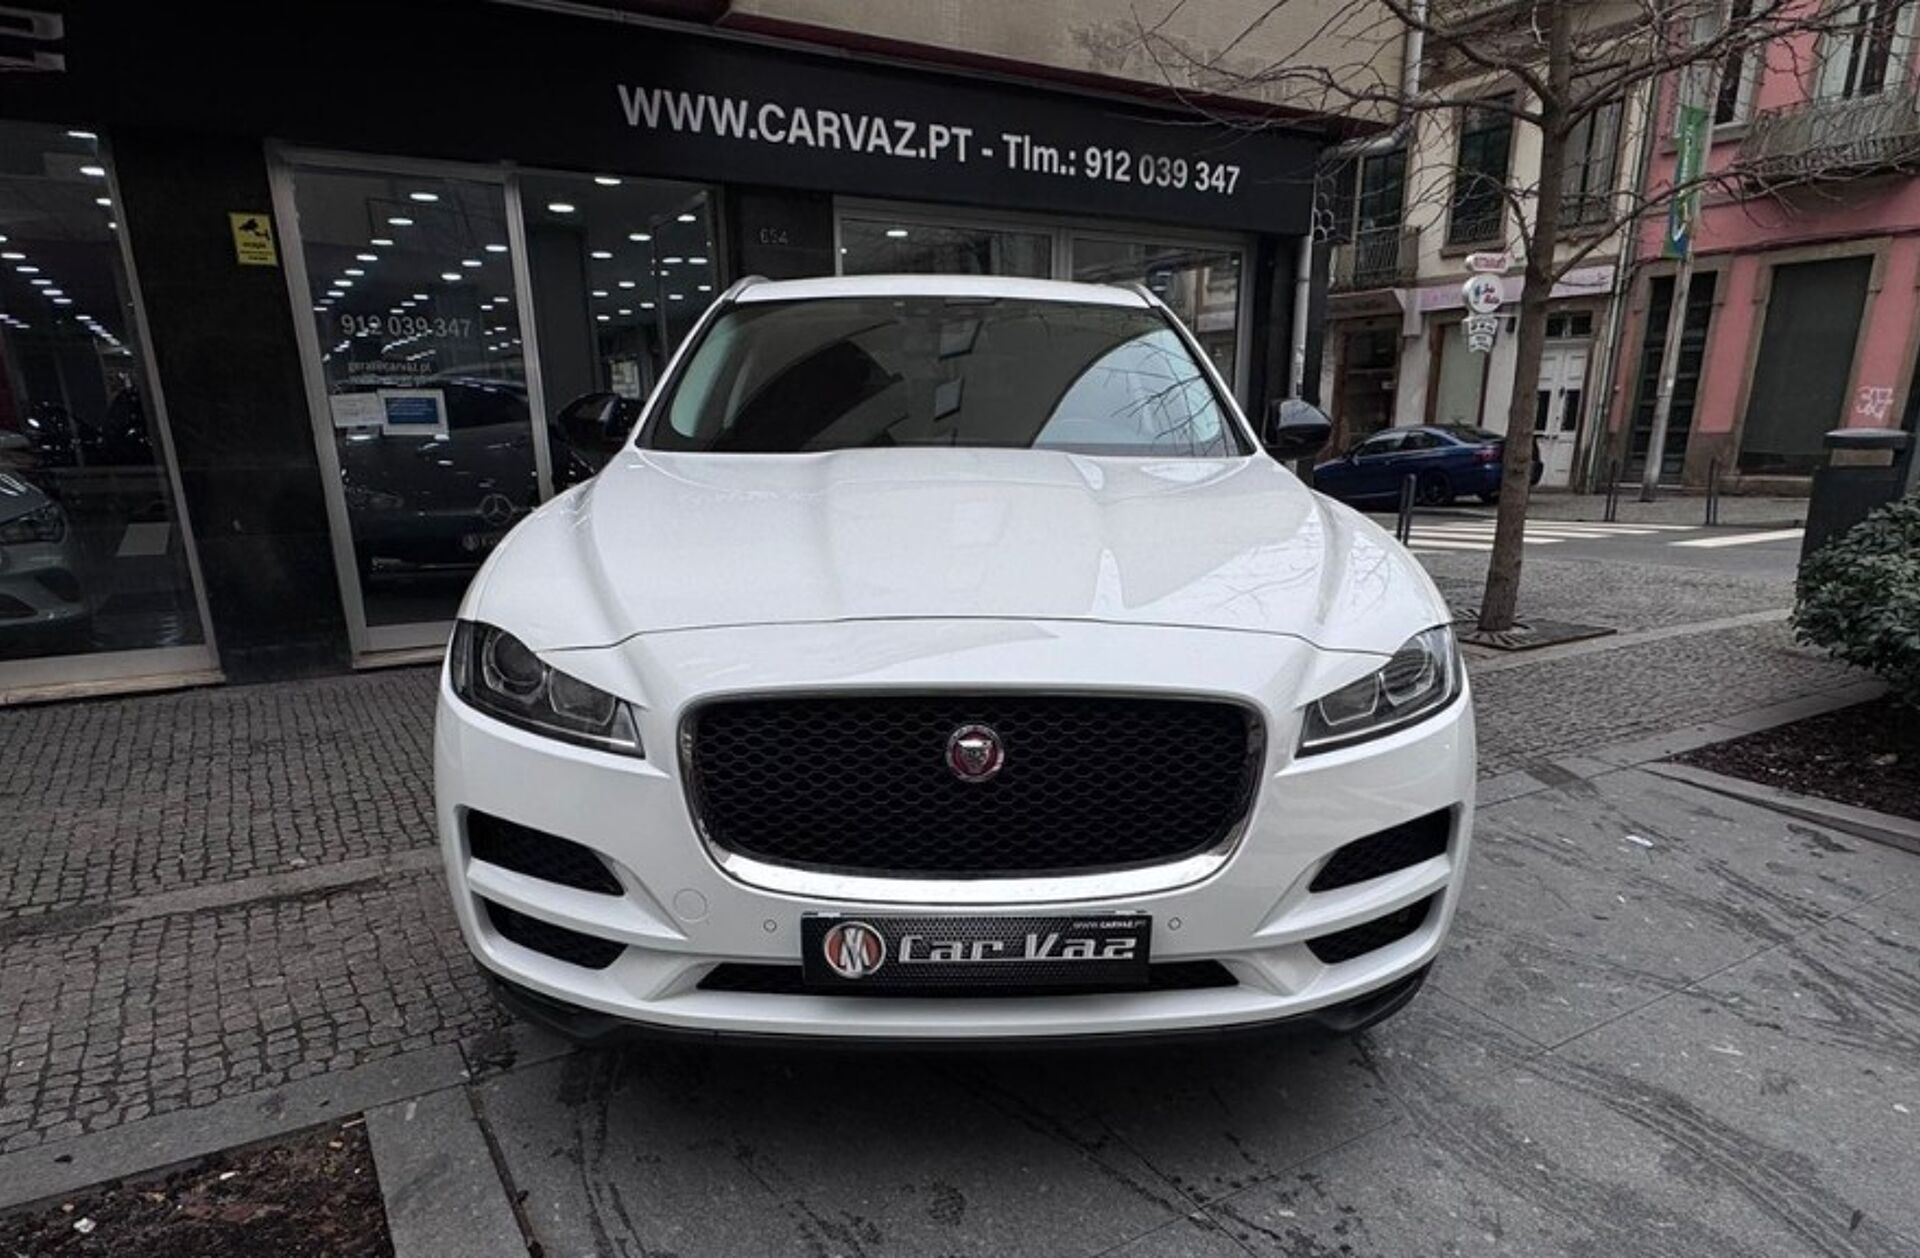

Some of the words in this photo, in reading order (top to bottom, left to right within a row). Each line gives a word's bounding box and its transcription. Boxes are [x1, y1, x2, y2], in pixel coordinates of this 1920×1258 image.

[617, 84, 973, 162] WWW.CARVAZ.PT
[1002, 133, 1076, 176] Tlm.:
[1085, 146, 1131, 182] 912
[1138, 154, 1188, 189] 039
[1194, 161, 1240, 195] 347
[341, 314, 382, 335] 912
[387, 316, 428, 337] 039
[434, 318, 471, 337] 347
[899, 934, 1003, 962] Car
